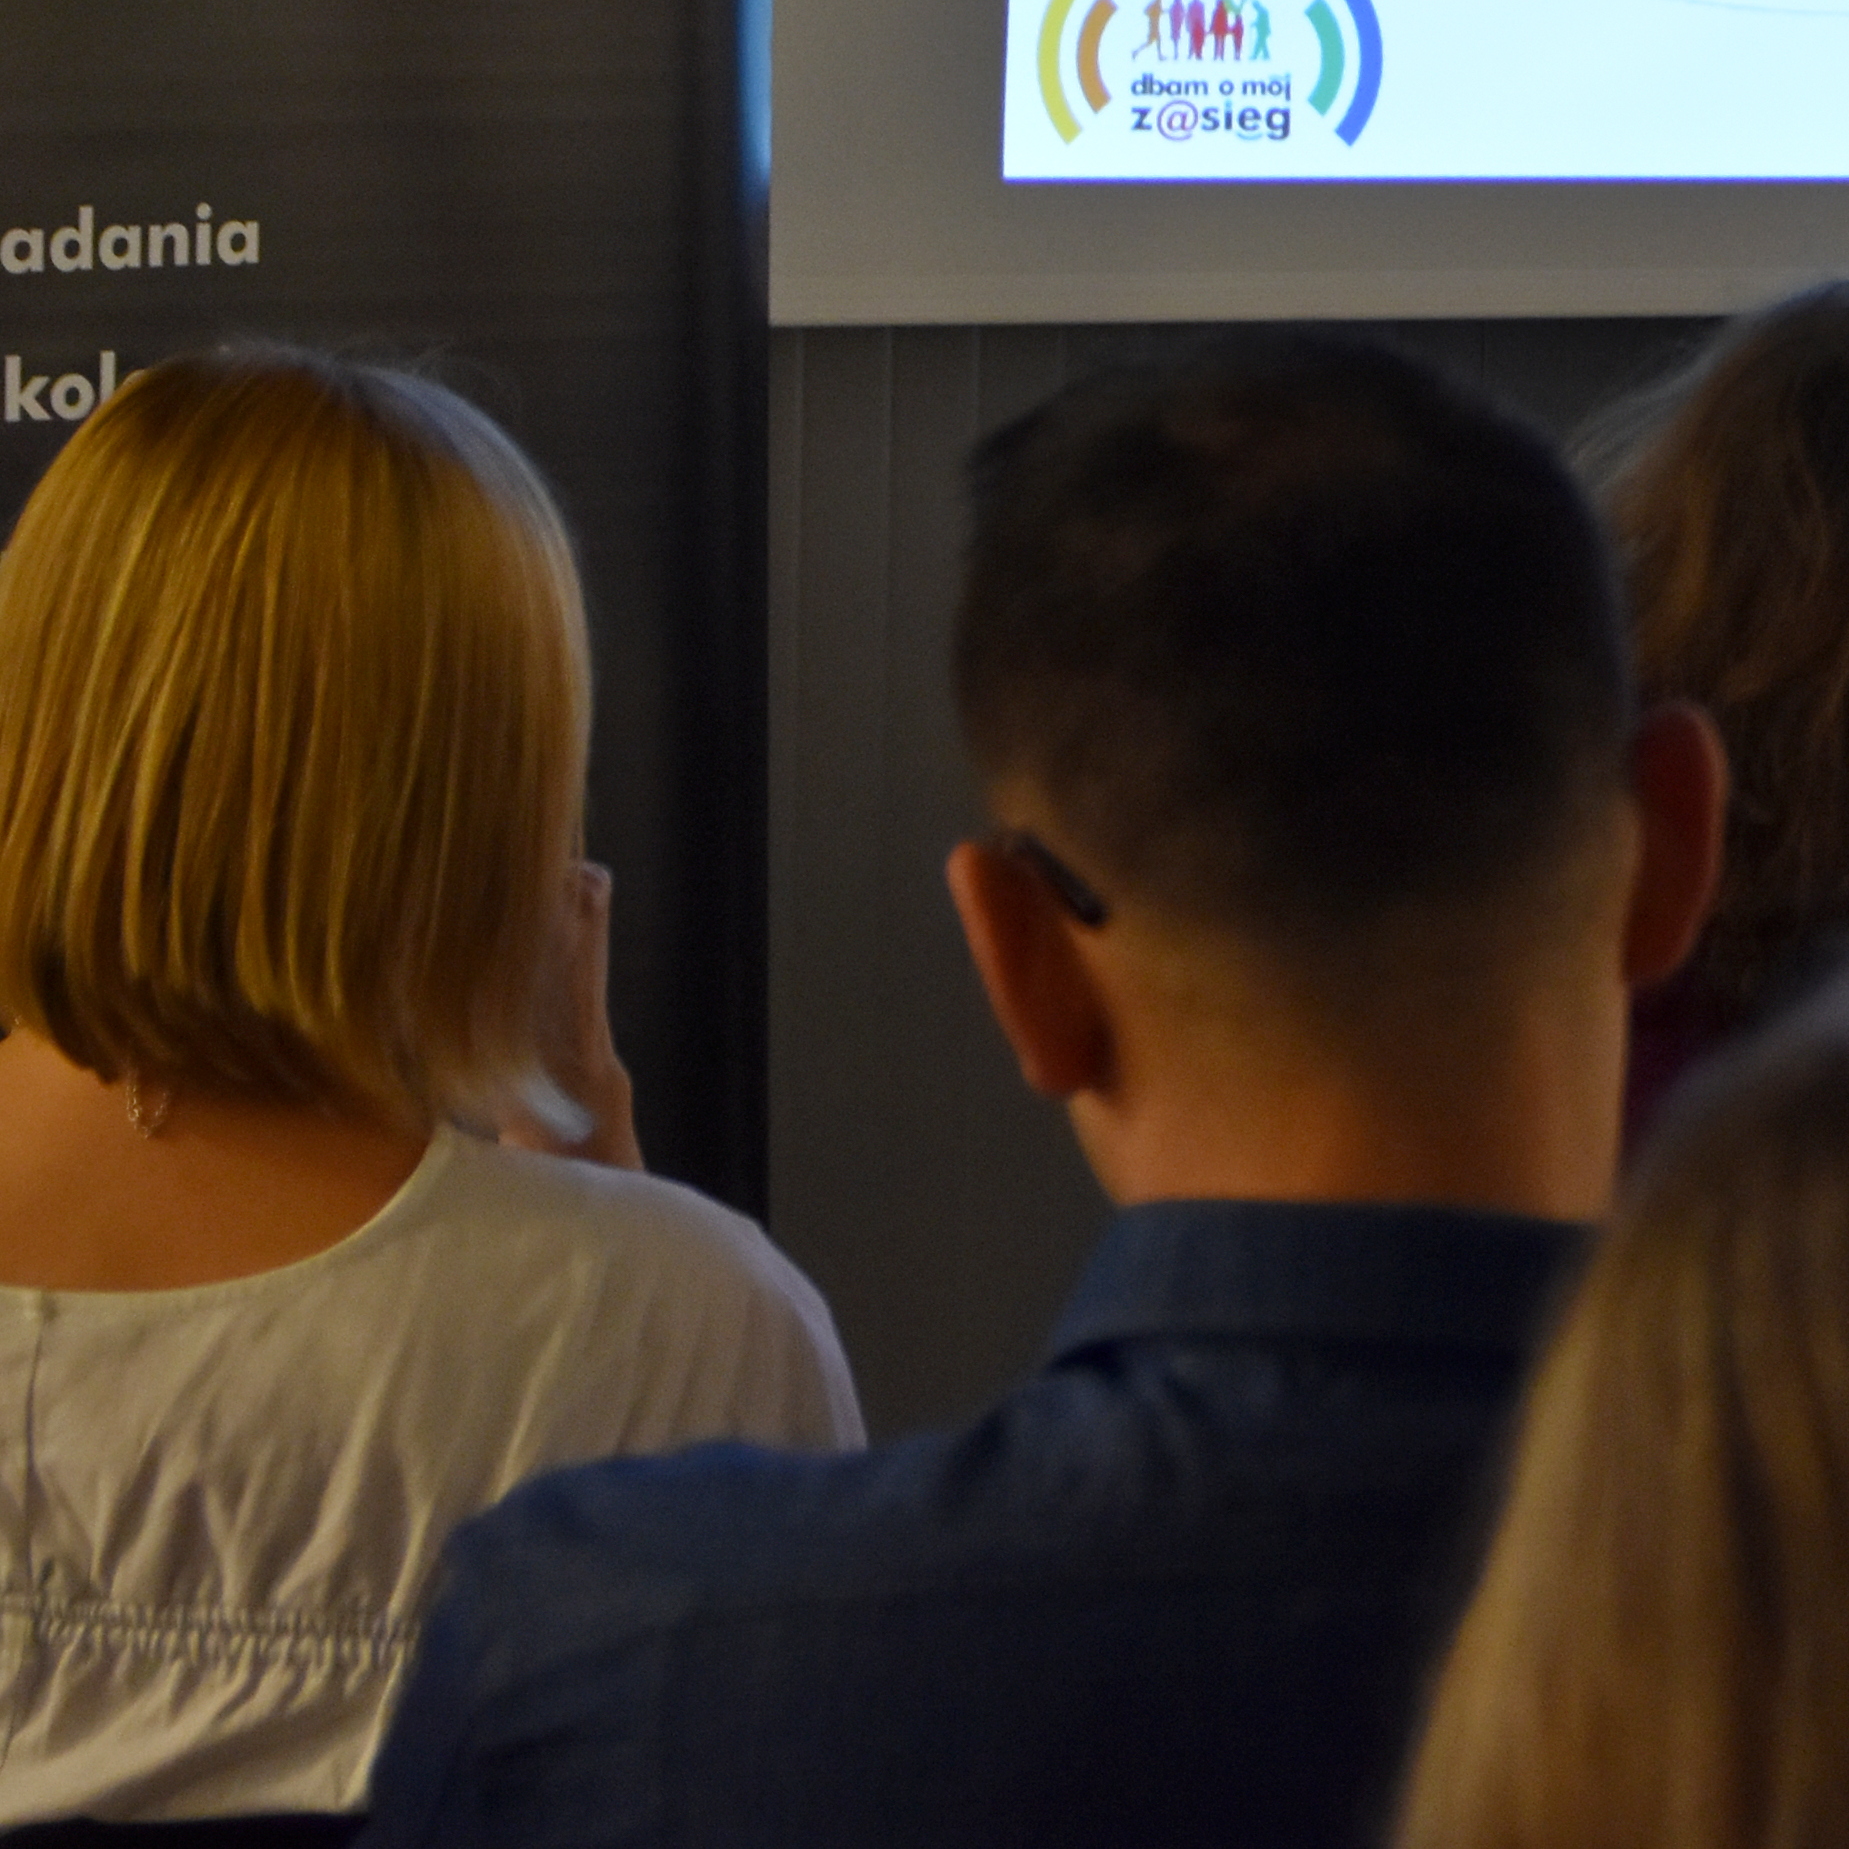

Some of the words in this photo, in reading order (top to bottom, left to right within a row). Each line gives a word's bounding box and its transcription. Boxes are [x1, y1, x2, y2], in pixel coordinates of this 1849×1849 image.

[1130, 73, 1209, 97] dbam
[1218, 78, 1235, 97] o
[1129, 98, 1292, 142] z@sieg
[4, 349, 150, 424] kol
